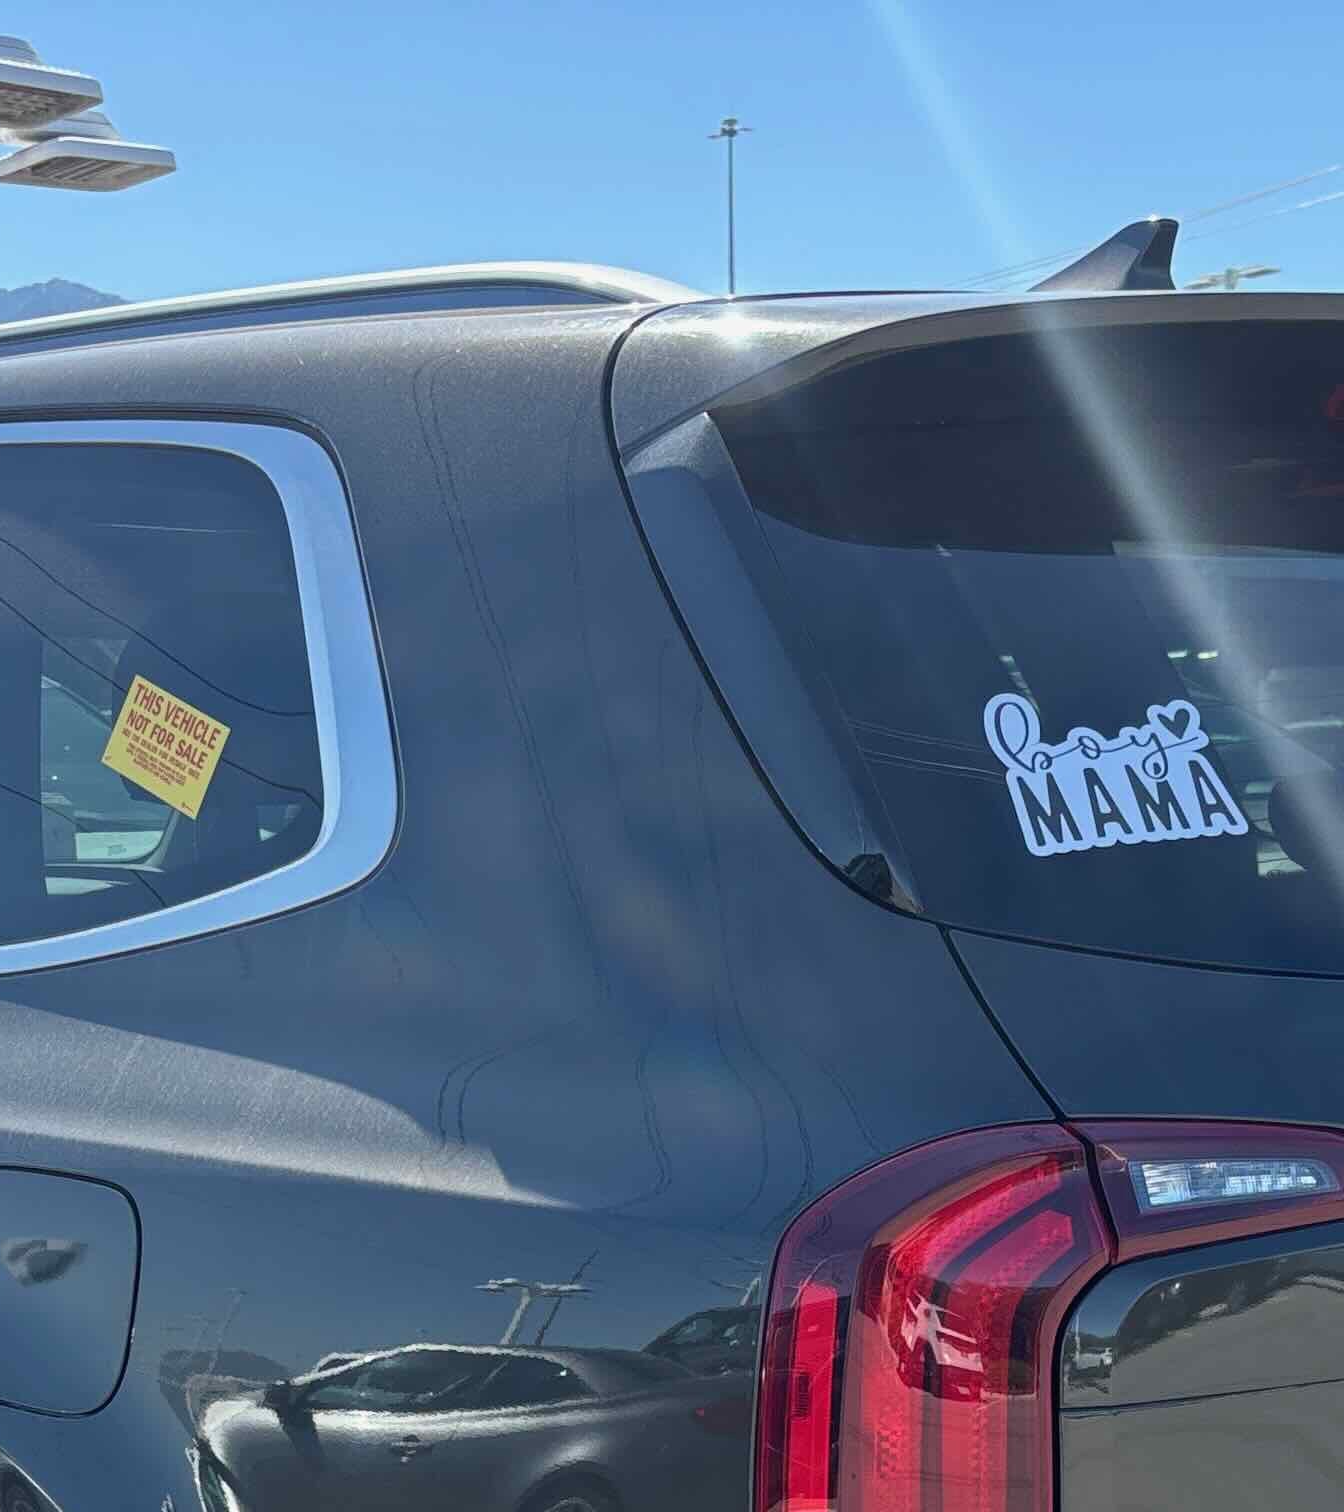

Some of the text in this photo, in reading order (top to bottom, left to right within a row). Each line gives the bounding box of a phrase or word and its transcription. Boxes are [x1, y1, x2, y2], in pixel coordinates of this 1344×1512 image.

[126, 709, 152, 735] NOT
[150, 723, 176, 751] FOR
[175, 739, 209, 770] SALE
[133, 682, 222, 751] THIS VEHICLE
[993, 701, 1199, 780] boy
[1016, 759, 1238, 848] MAMA
